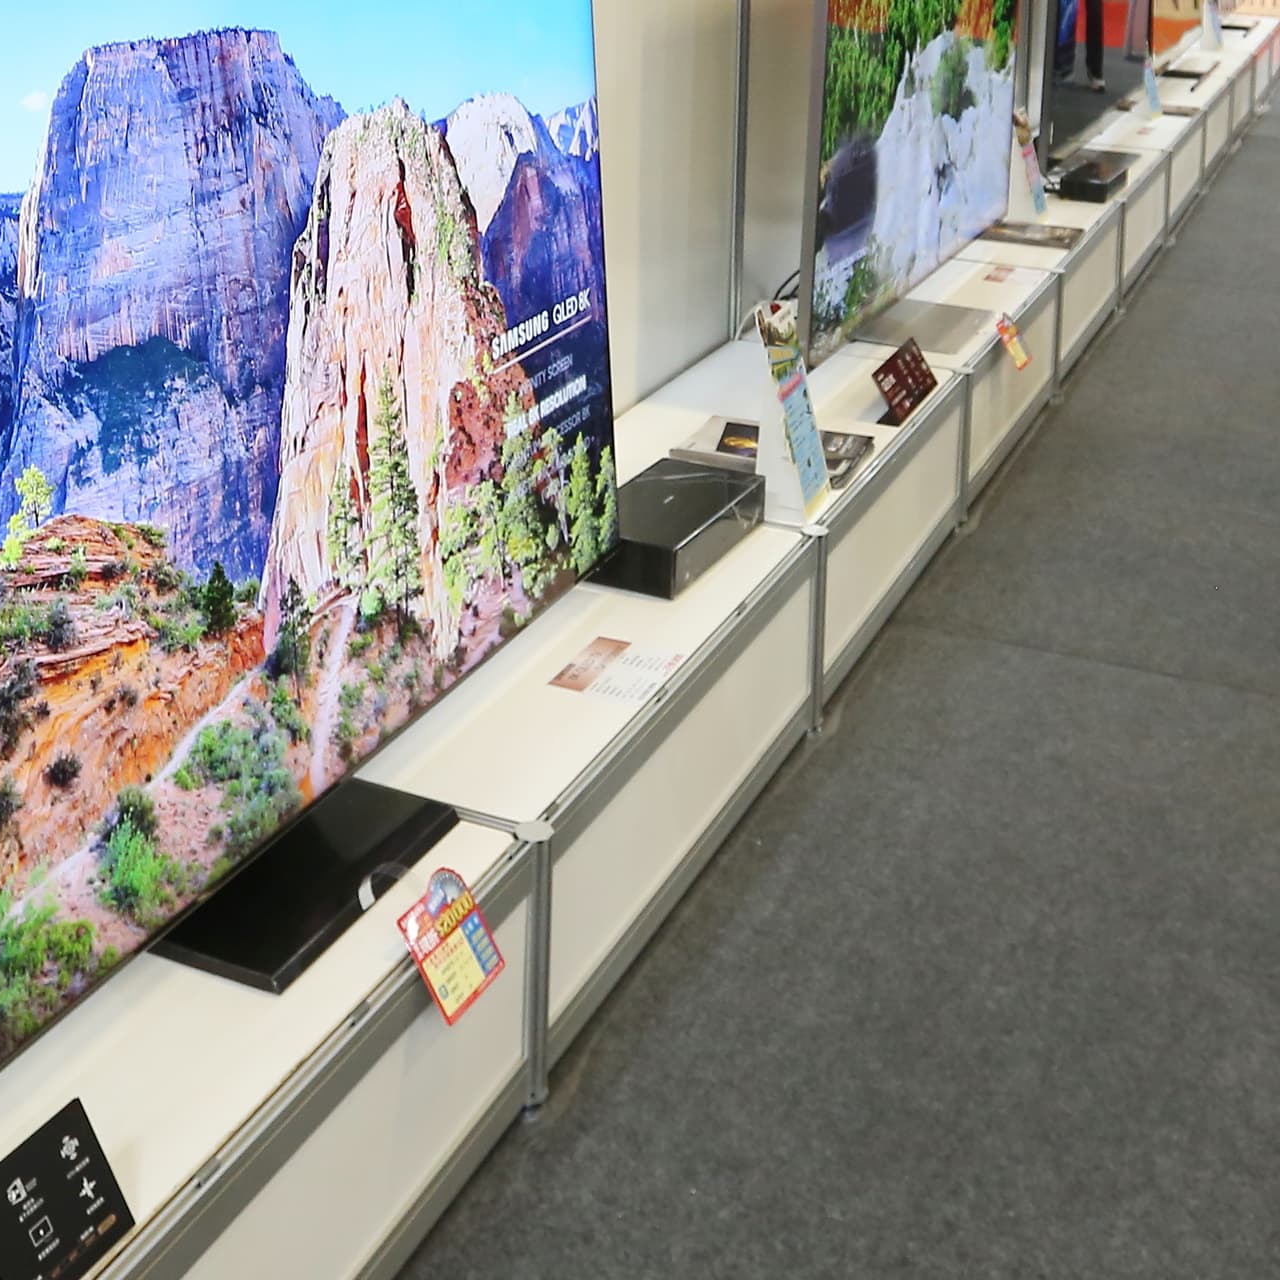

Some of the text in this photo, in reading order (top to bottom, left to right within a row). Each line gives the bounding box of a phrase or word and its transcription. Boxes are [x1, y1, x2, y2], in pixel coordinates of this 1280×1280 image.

[491, 288, 591, 360] SAMSUNG QLED 8K
[540, 374, 587, 418] RESOLUTION
